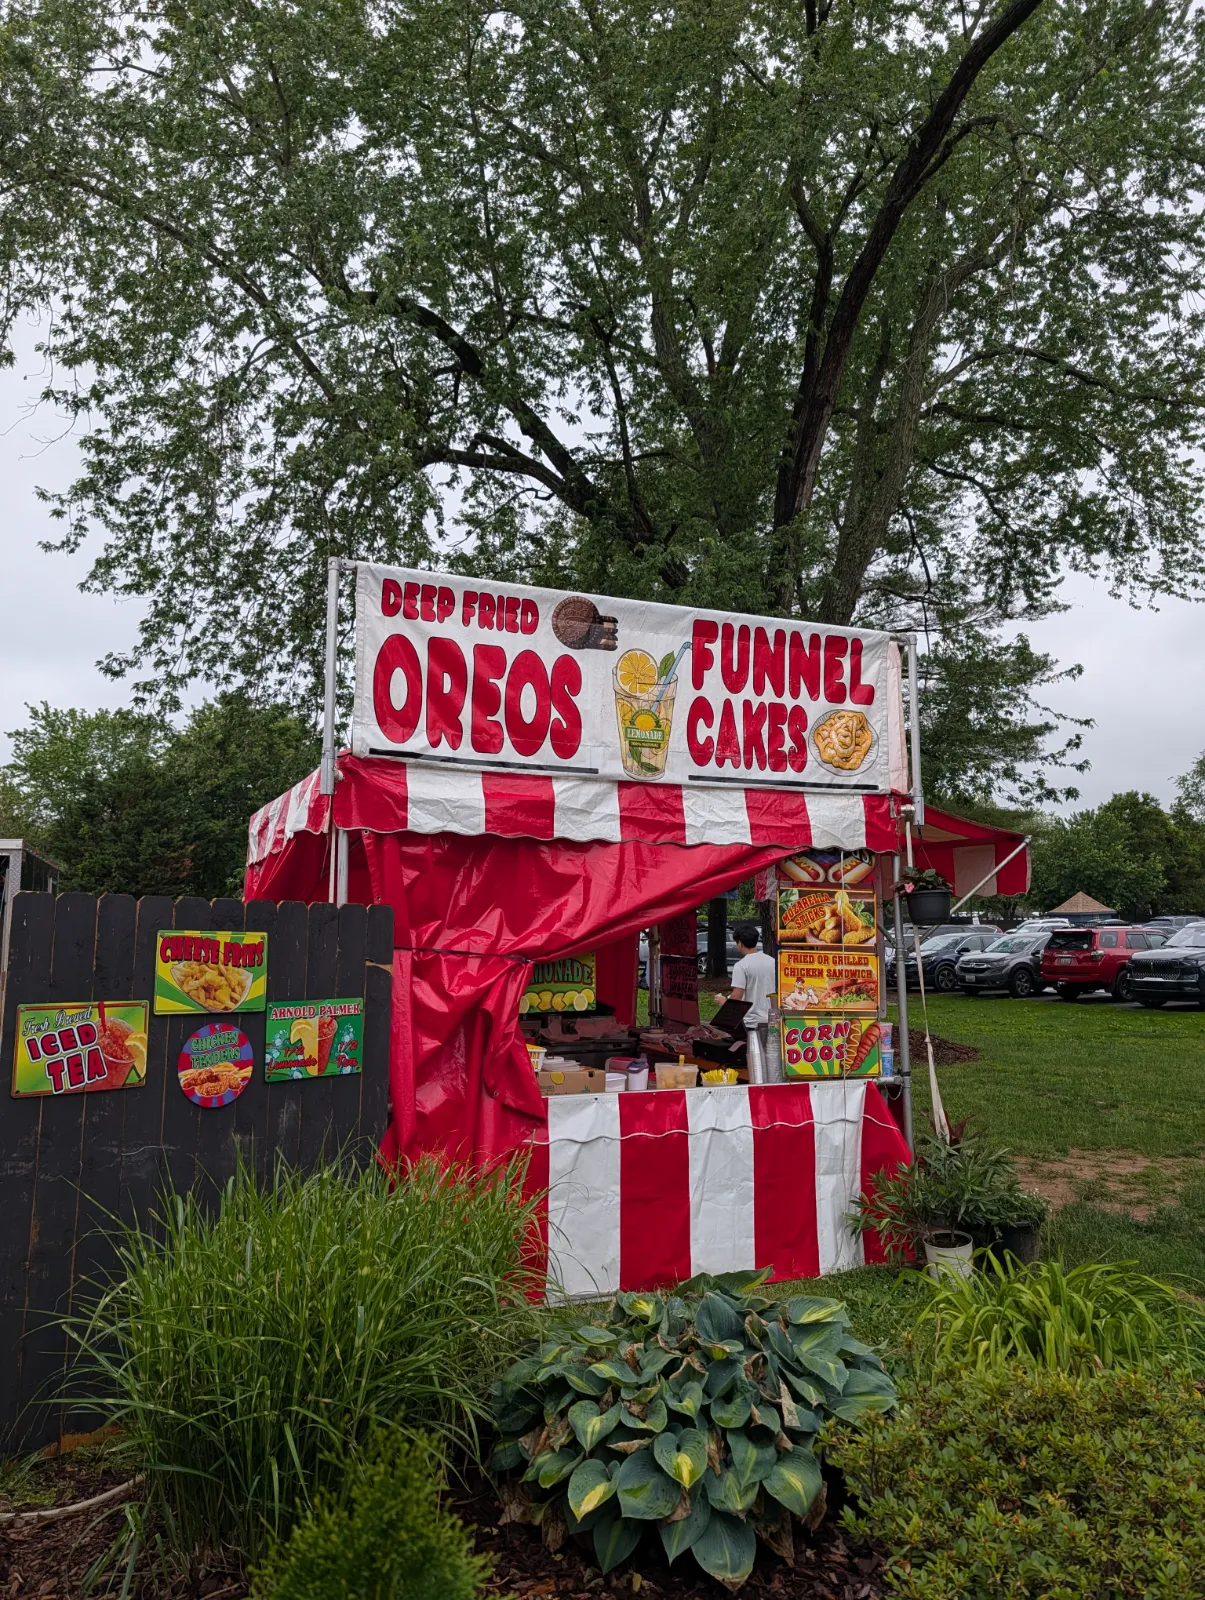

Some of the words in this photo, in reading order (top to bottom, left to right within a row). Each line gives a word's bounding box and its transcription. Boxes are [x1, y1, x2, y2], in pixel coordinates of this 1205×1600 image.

[381, 578, 456, 624] DEEP
[462, 590, 540, 635] FRIED
[691, 618, 875, 706] FUNNEL
[373, 633, 582, 760] OREOS
[627, 728, 663, 741] LEMONADE
[686, 695, 808, 773] CAKES
[782, 893, 831, 924] MOZARELLA
[794, 906, 826, 928] STICKS
[160, 936, 221, 964] CHEESE
[223, 941, 265, 968] FRIES
[787, 954, 815, 965] FRIED
[817, 955, 830, 965] OR
[832, 956, 869, 966] GRILLED
[531, 959, 592, 985] MONADE
[784, 967, 824, 978] CHICKEN
[826, 969, 873, 979] SANDWICH
[23, 1017, 50, 1036] Fresh
[54, 1006, 93, 1028] Brewed
[271, 1006, 316, 1020] ARNOLD
[319, 1003, 360, 1016] PALMER
[26, 1023, 98, 1062] ICED
[191, 1031, 239, 1052] CHICKEN
[785, 1020, 851, 1046] CORN
[284, 1045, 305, 1057] 1/2
[337, 1040, 358, 1052] 1/2
[786, 1043, 848, 1065] DOGS
[191, 1047, 241, 1069] TENDERS
[267, 1054, 318, 1071] Lemonade
[336, 1054, 358, 1068] Tea
[46, 1046, 108, 1094] TEA
